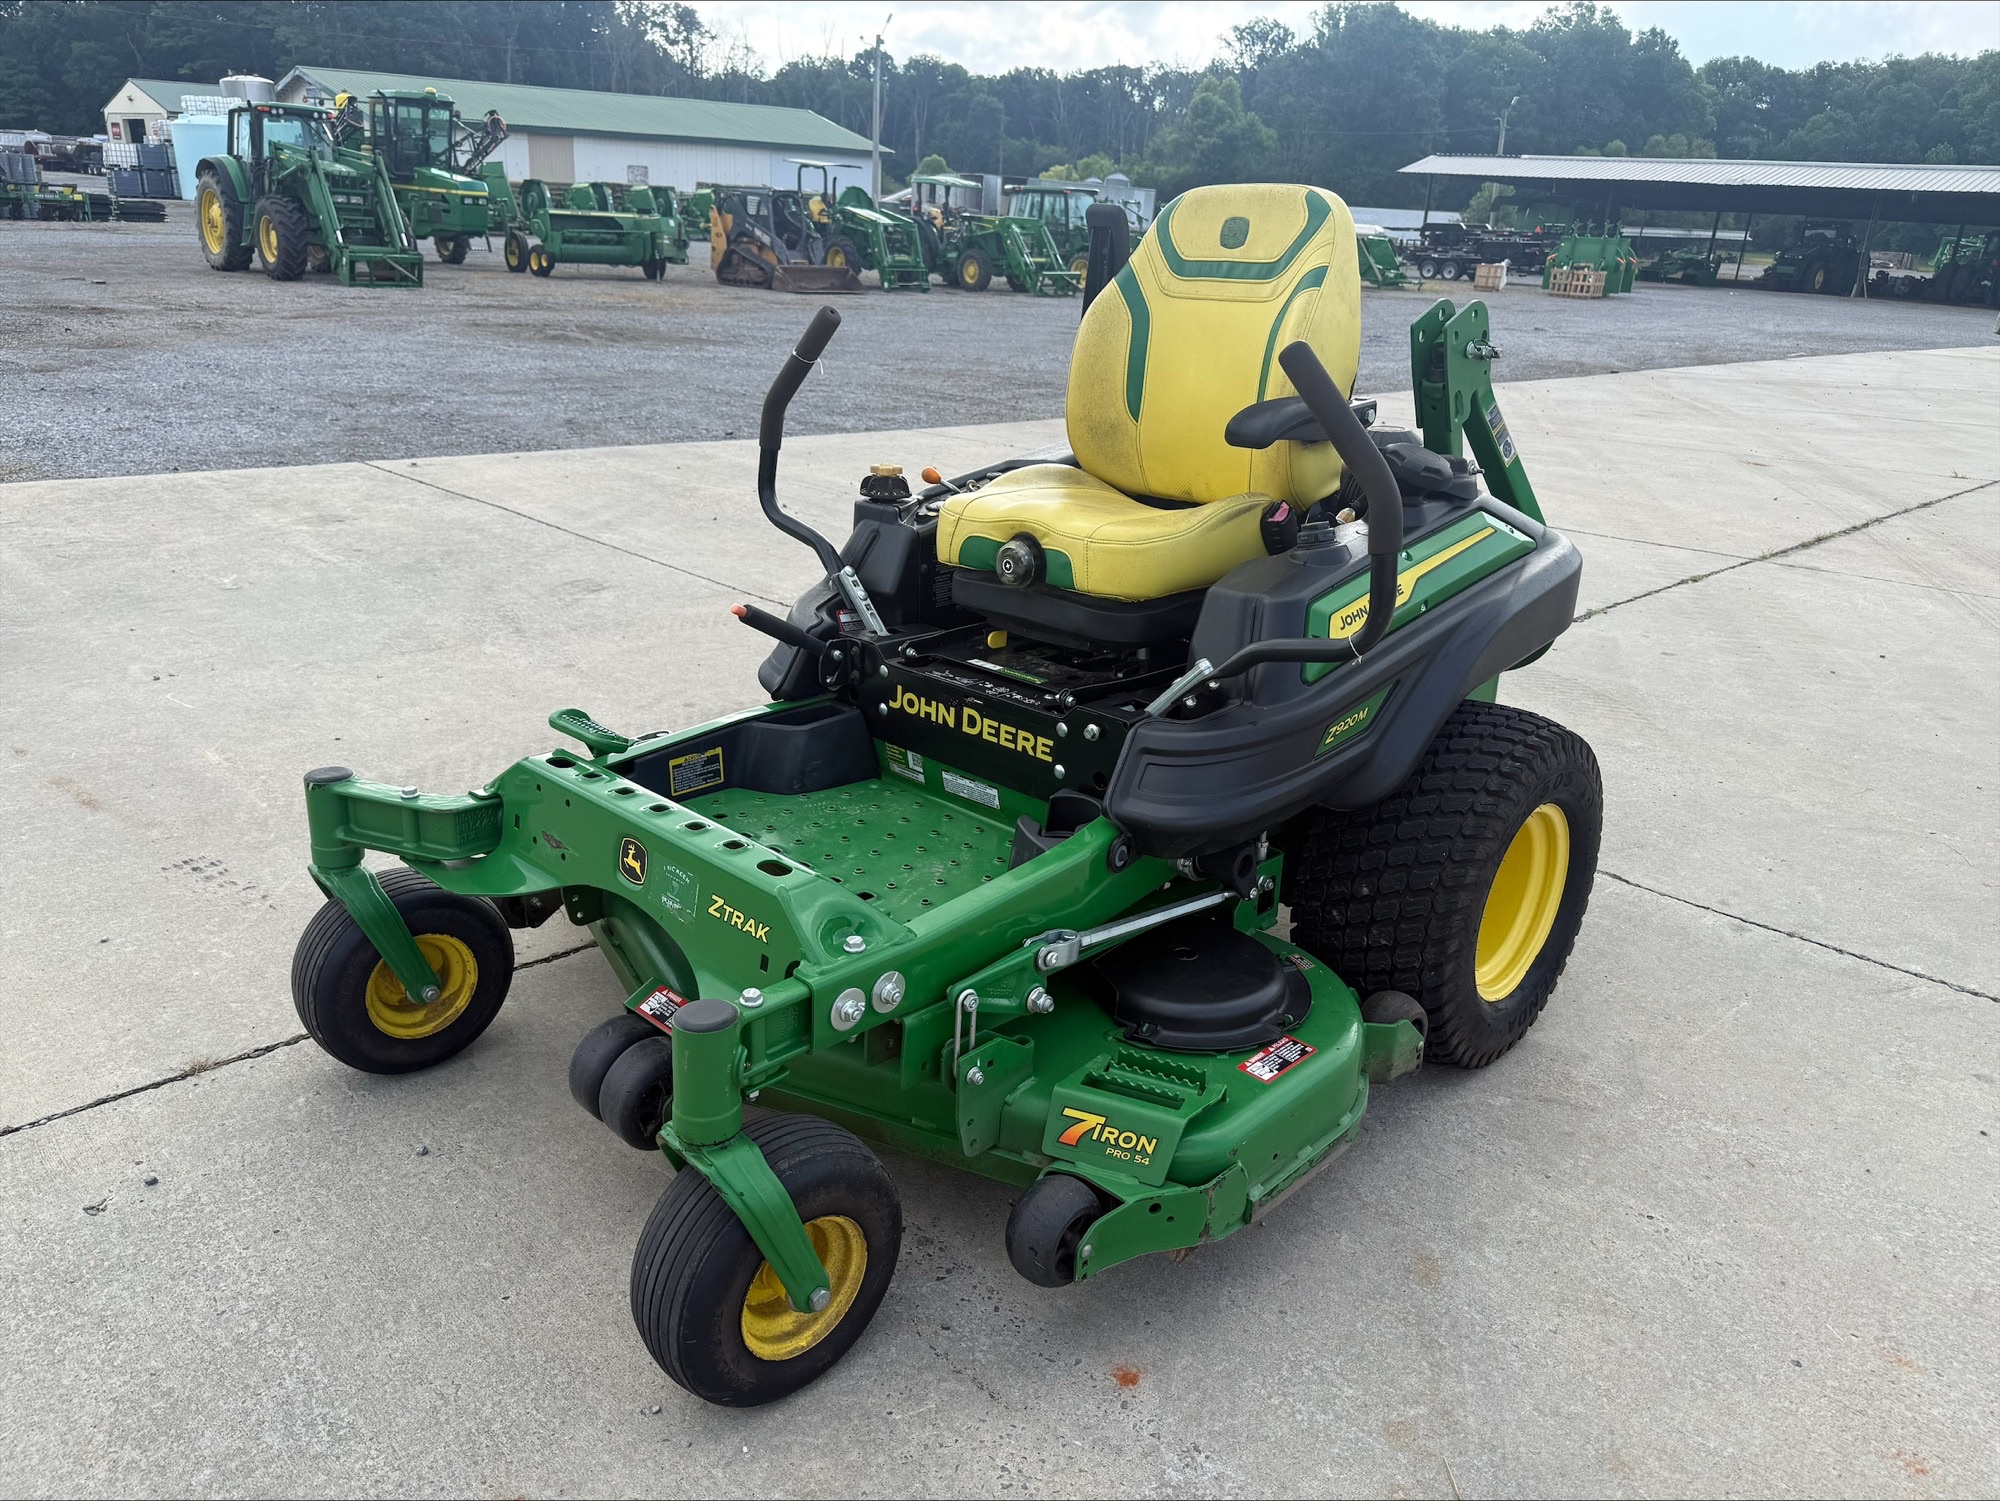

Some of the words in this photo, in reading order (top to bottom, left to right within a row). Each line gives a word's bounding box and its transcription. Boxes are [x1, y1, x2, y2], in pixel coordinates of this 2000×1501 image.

[1340, 604, 1369, 631] JOHN
[888, 684, 955, 728] JOHN
[962, 706, 1054, 763] DEERE
[1324, 706, 1369, 744] Z920M
[707, 894, 772, 944] ZTRAK
[1105, 1147, 1131, 1160] PRO
[1133, 1155, 1150, 1166] 54
